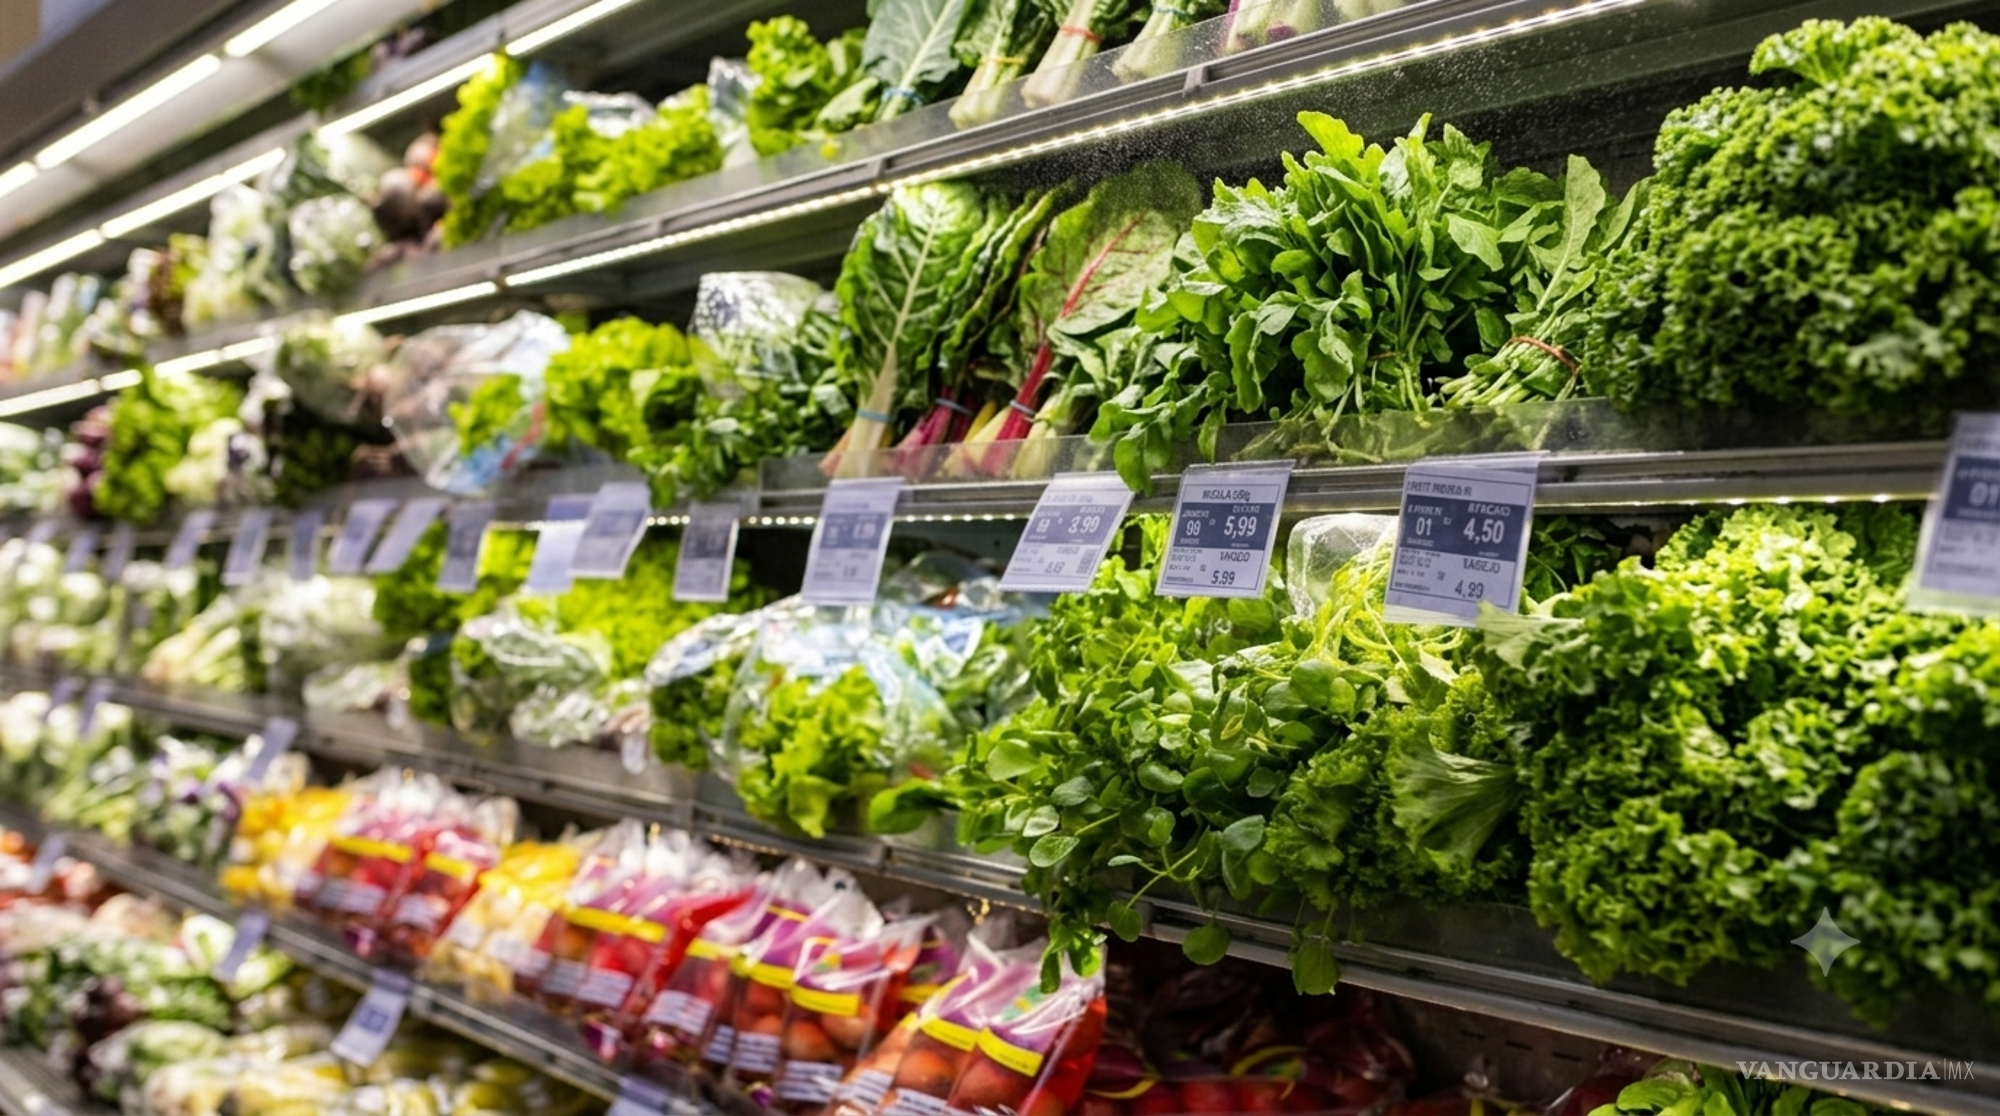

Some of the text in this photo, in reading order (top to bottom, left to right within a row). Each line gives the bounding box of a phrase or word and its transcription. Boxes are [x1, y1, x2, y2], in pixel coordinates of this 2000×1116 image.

[1223, 515, 1258, 539] 5,99
[1415, 516, 1433, 536] 01
[1463, 517, 1505, 544] 4,50
